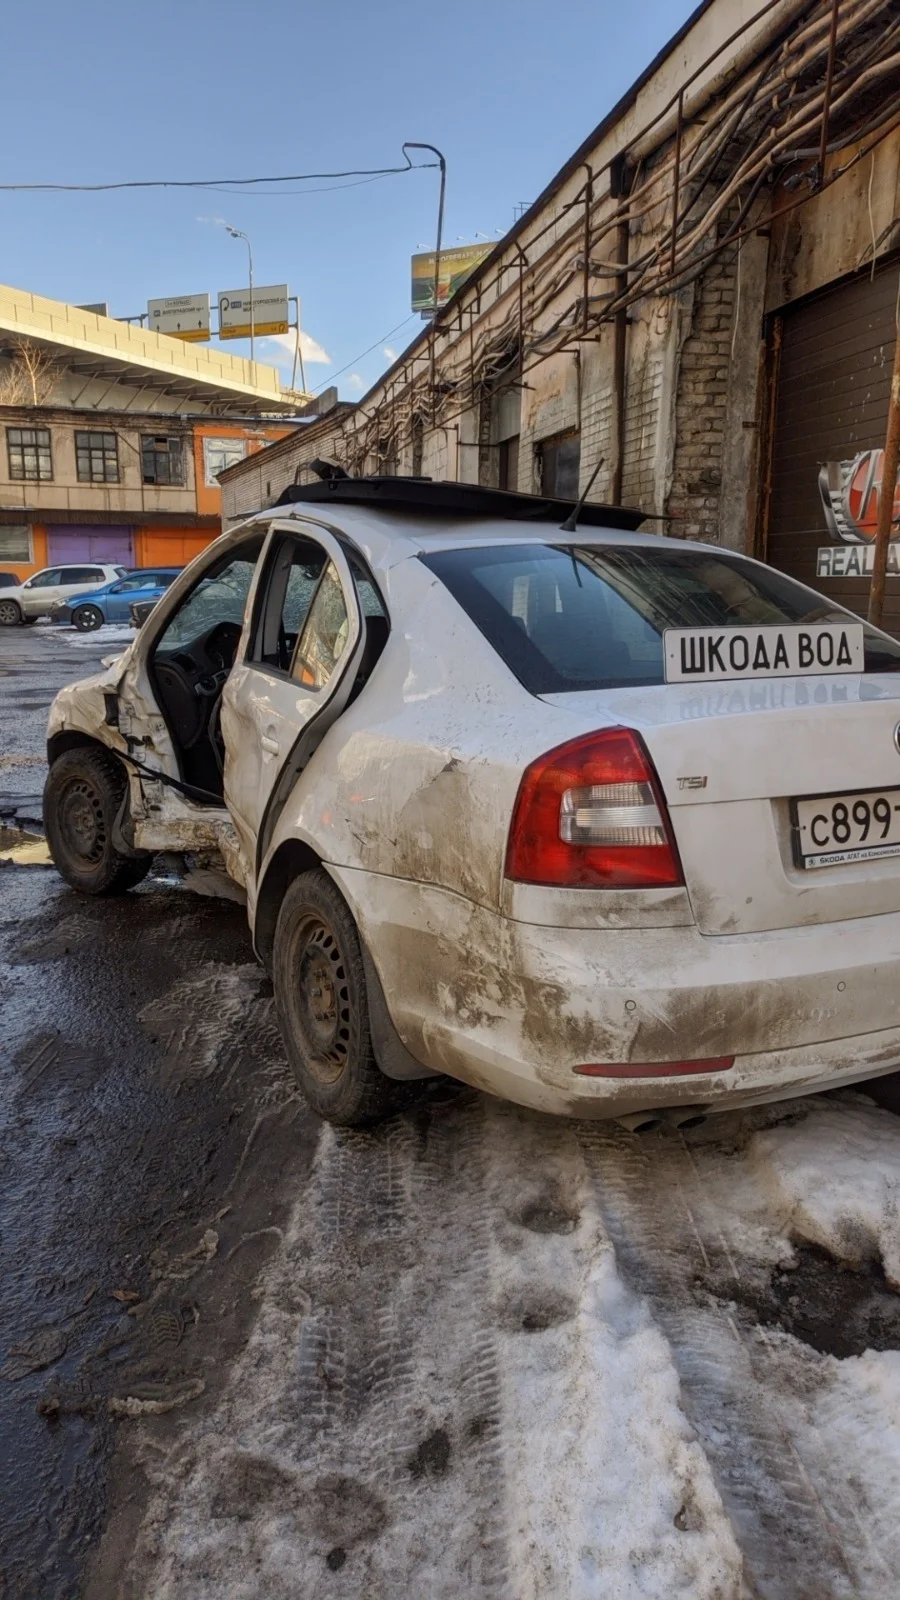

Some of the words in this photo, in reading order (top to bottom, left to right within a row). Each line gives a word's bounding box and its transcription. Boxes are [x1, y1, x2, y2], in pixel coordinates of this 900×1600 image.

[680, 634, 789, 674] ШКОДА
[797, 631, 852, 668] ВОД
[676, 775, 708, 790] TSI
[810, 797, 900, 847] С899
